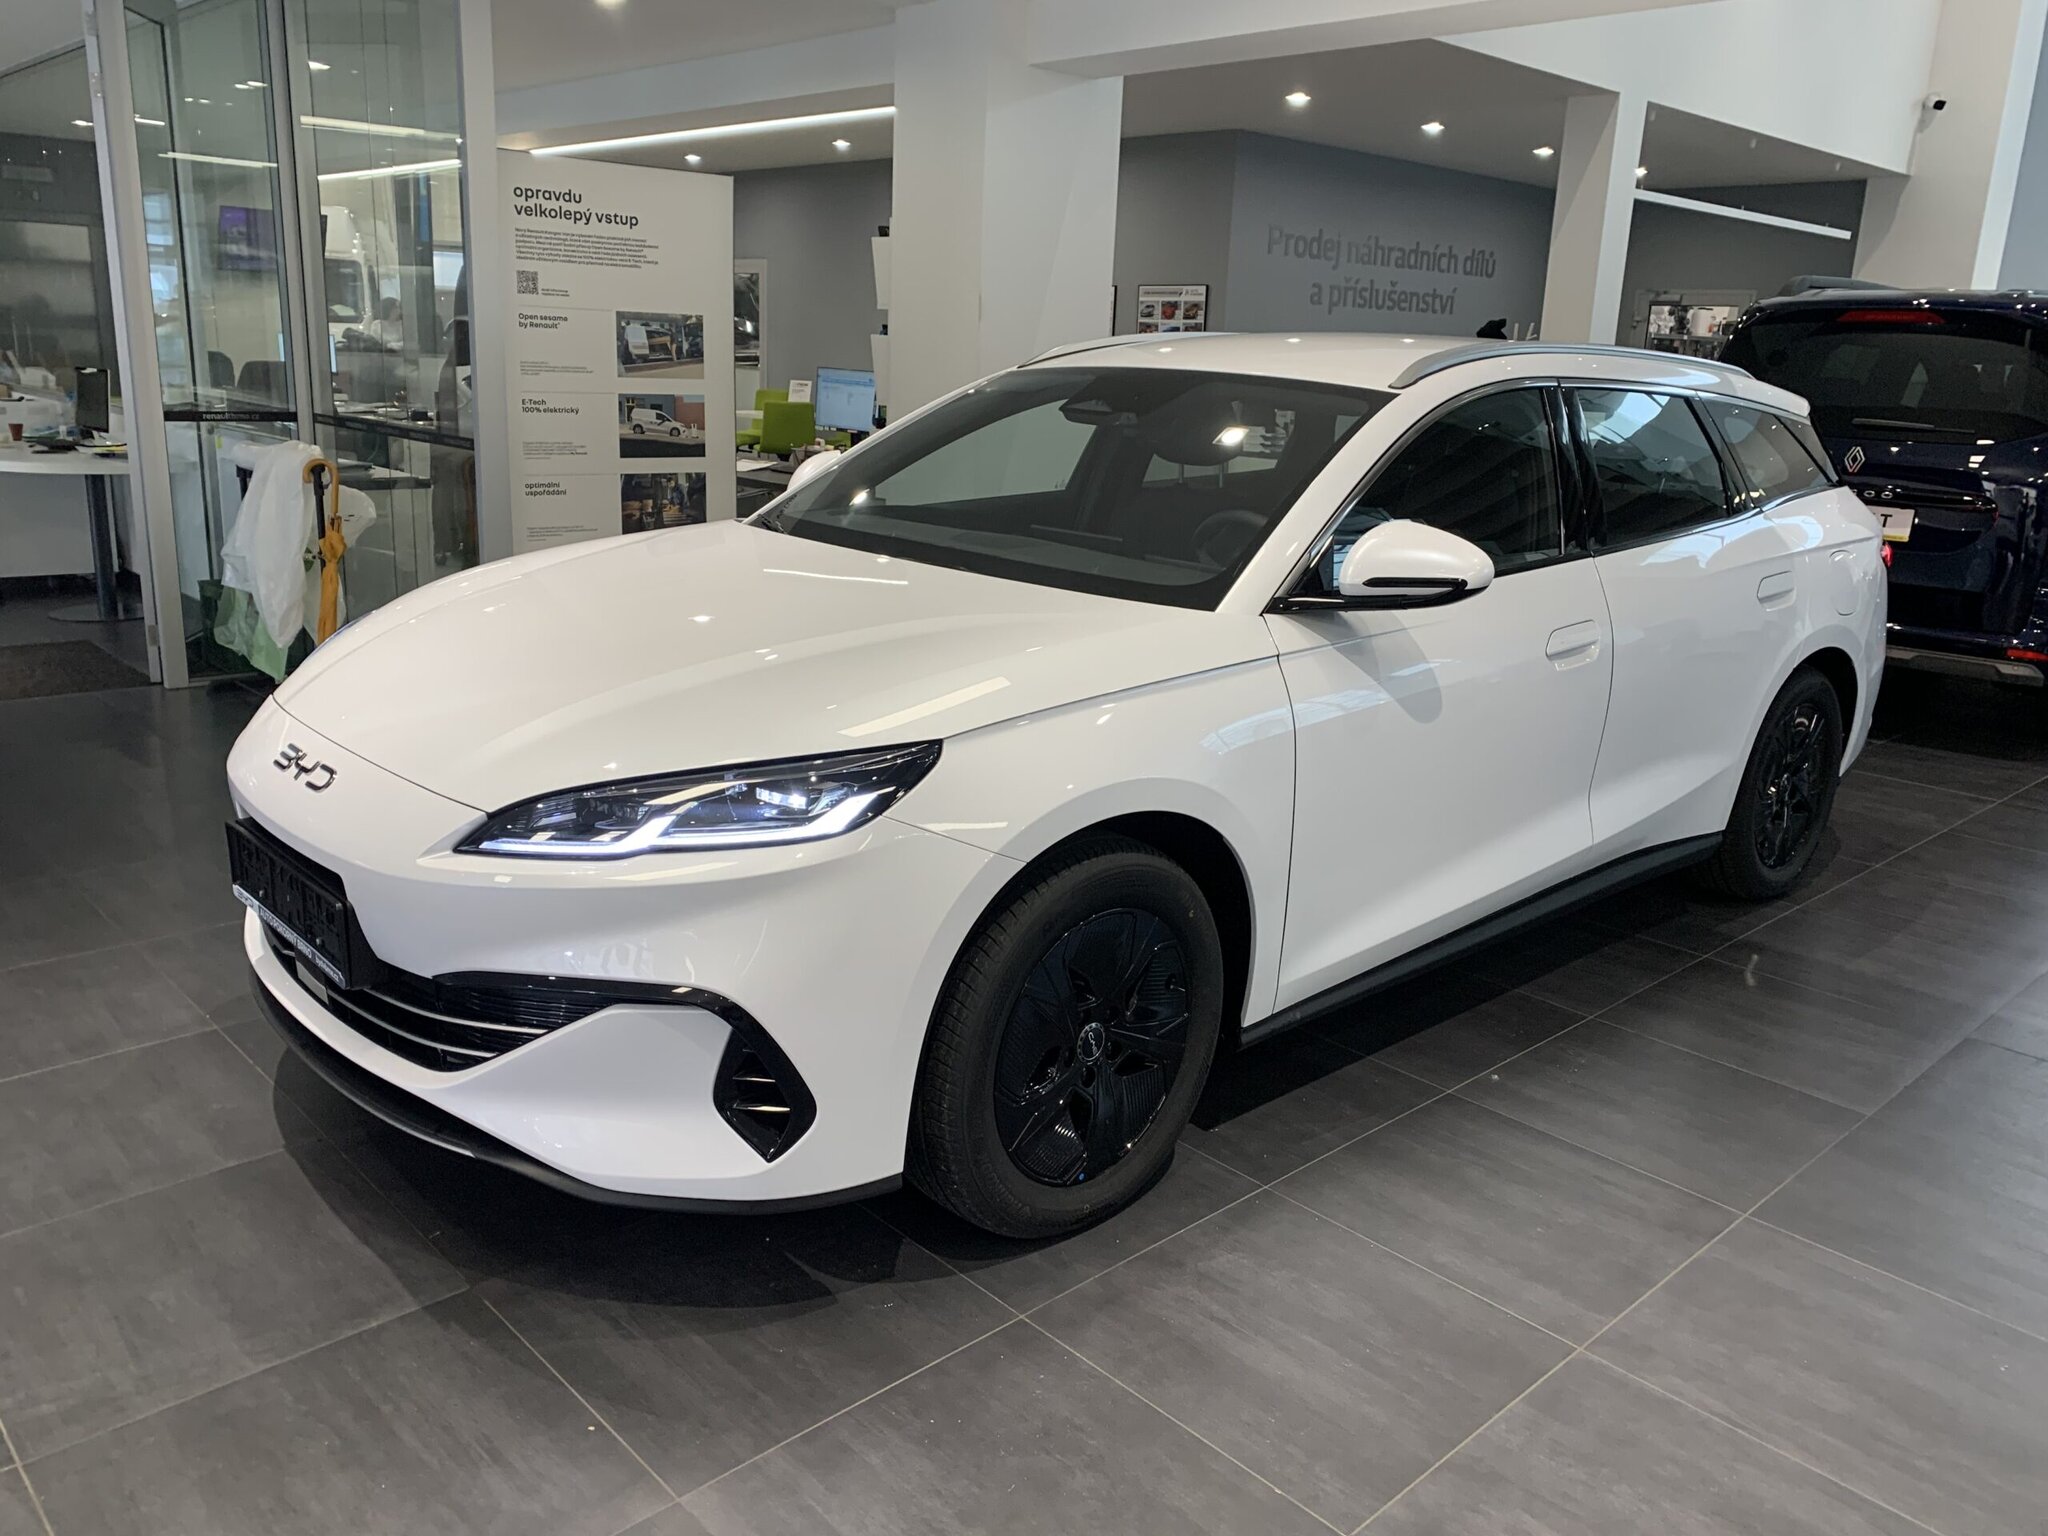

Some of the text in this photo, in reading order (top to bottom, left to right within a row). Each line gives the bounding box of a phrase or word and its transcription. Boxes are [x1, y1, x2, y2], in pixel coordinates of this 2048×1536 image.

[513, 186, 582, 204] opravdu
[514, 203, 639, 229] velkolepý vstup
[1267, 224, 1497, 279] Prodej náhradních dílů
[1309, 275, 1458, 315] a příslušenství
[518, 312, 568, 322] Open sesame
[518, 320, 528, 329] by
[273, 743, 338, 793] BYD
